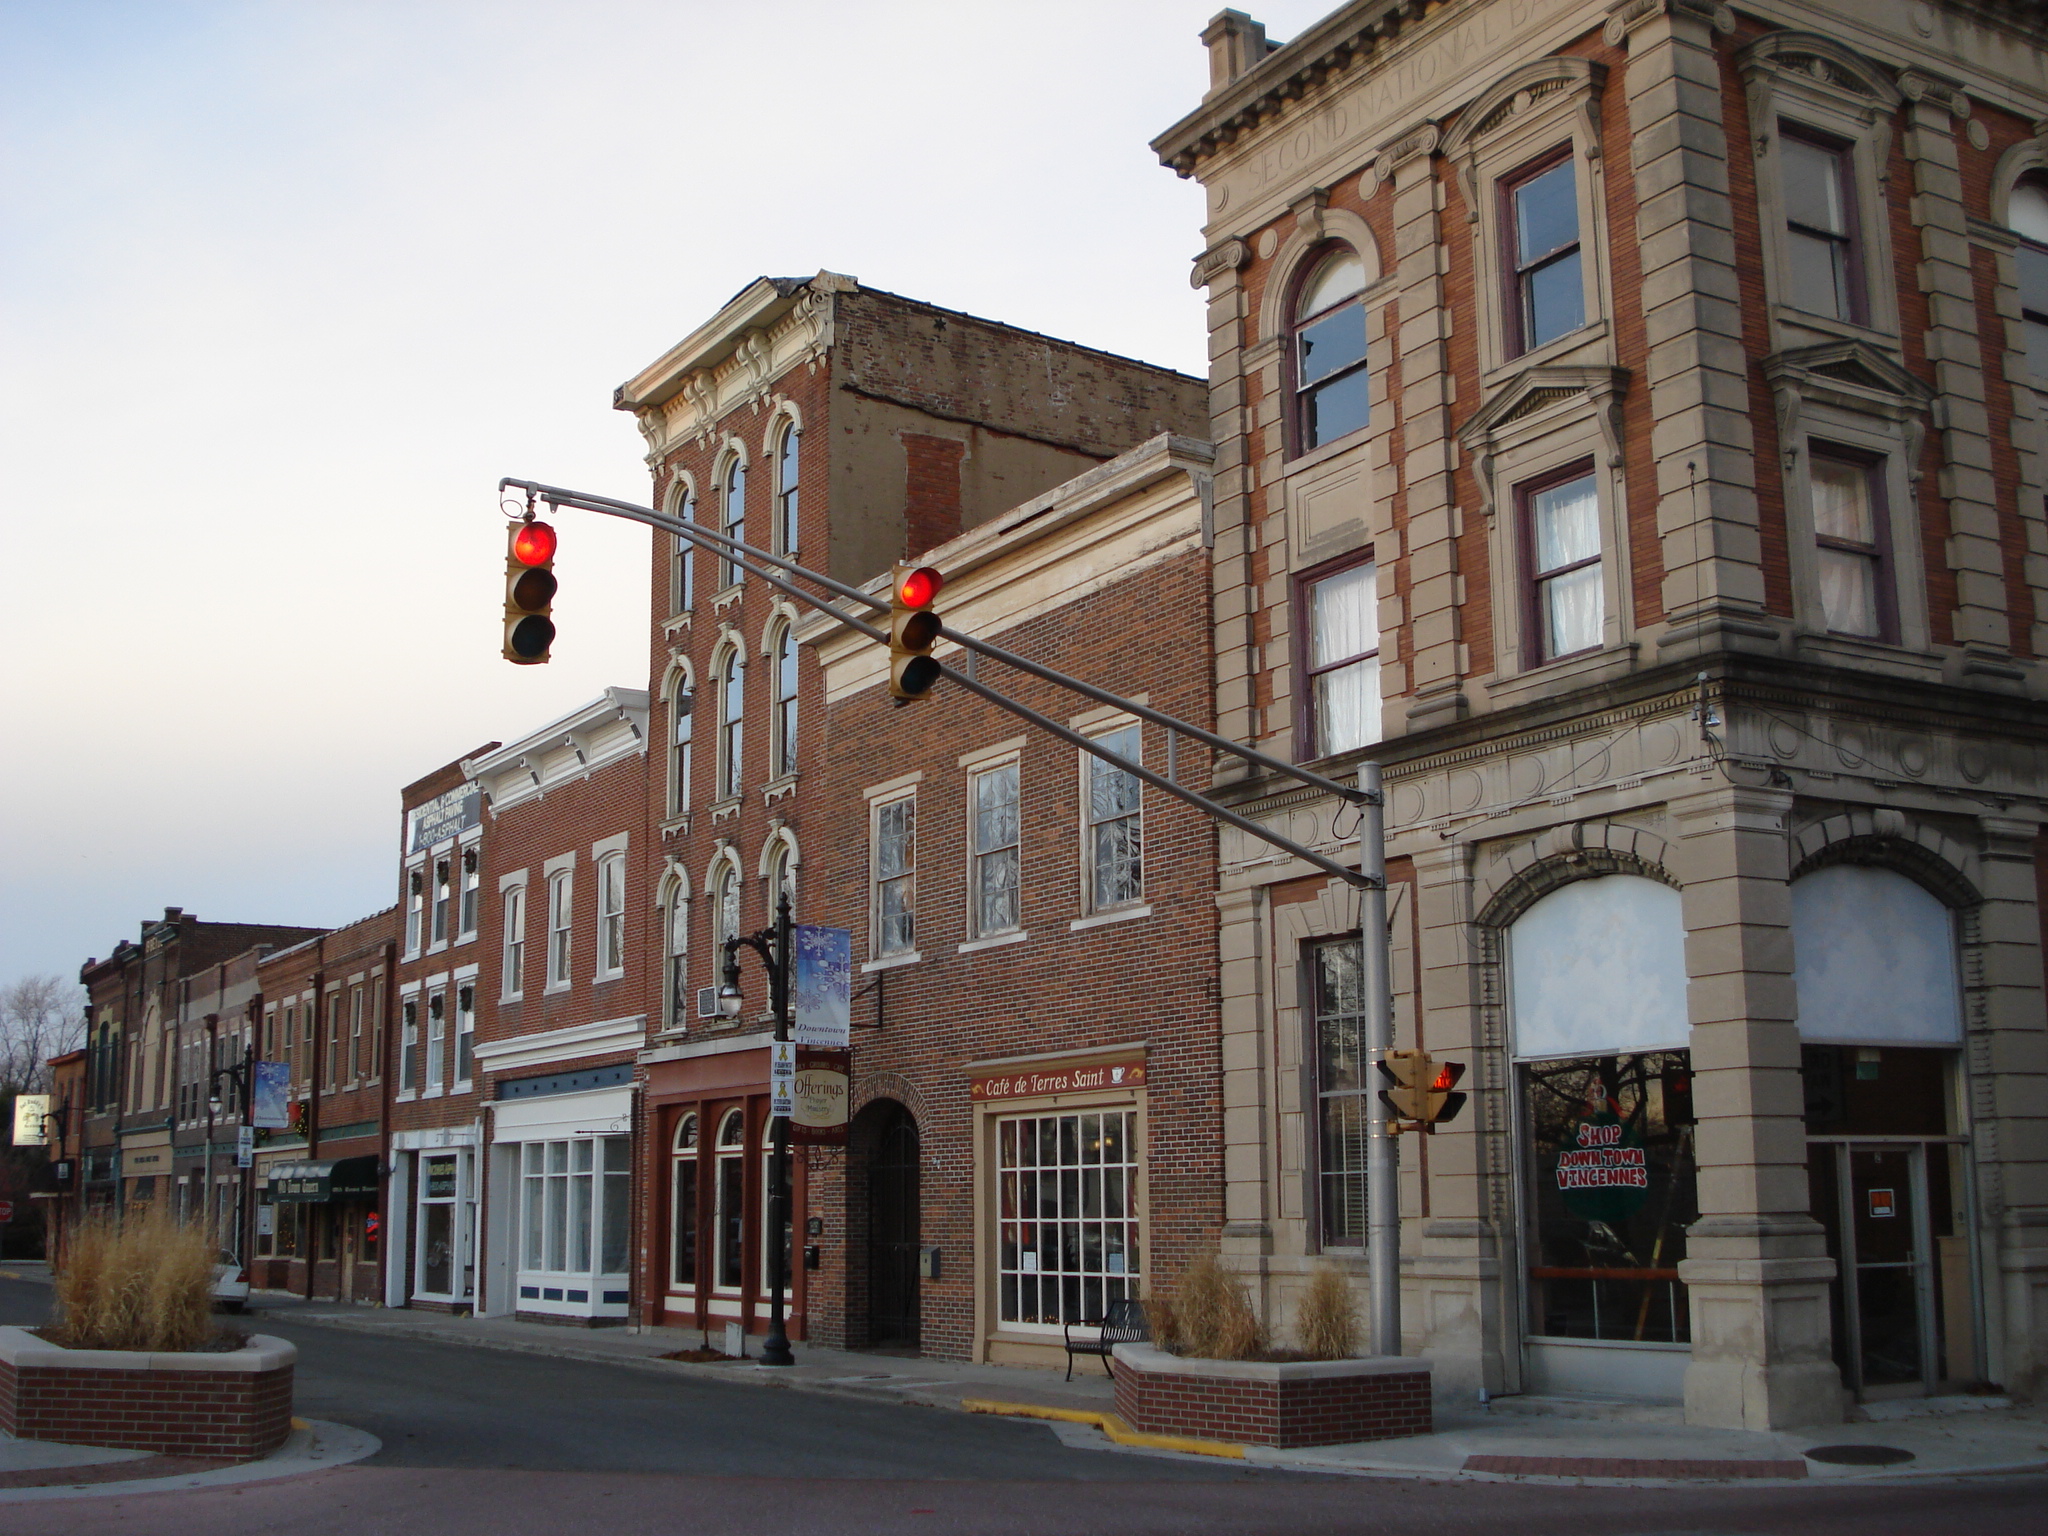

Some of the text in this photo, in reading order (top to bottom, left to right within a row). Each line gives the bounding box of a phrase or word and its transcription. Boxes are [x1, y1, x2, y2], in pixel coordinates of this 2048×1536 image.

[1247, 105, 1348, 191] SECOND
[1356, 15, 1501, 125] NATIONAL
[798, 1023, 847, 1035] Downtown
[800, 1036, 844, 1046] Vincennes
[794, 1073, 844, 1100] Offerings
[986, 1068, 1105, 1096] Café de Terres Saint
[1577, 1122, 1621, 1148] SHOP
[1556, 1167, 1647, 1190] VINCENNES
